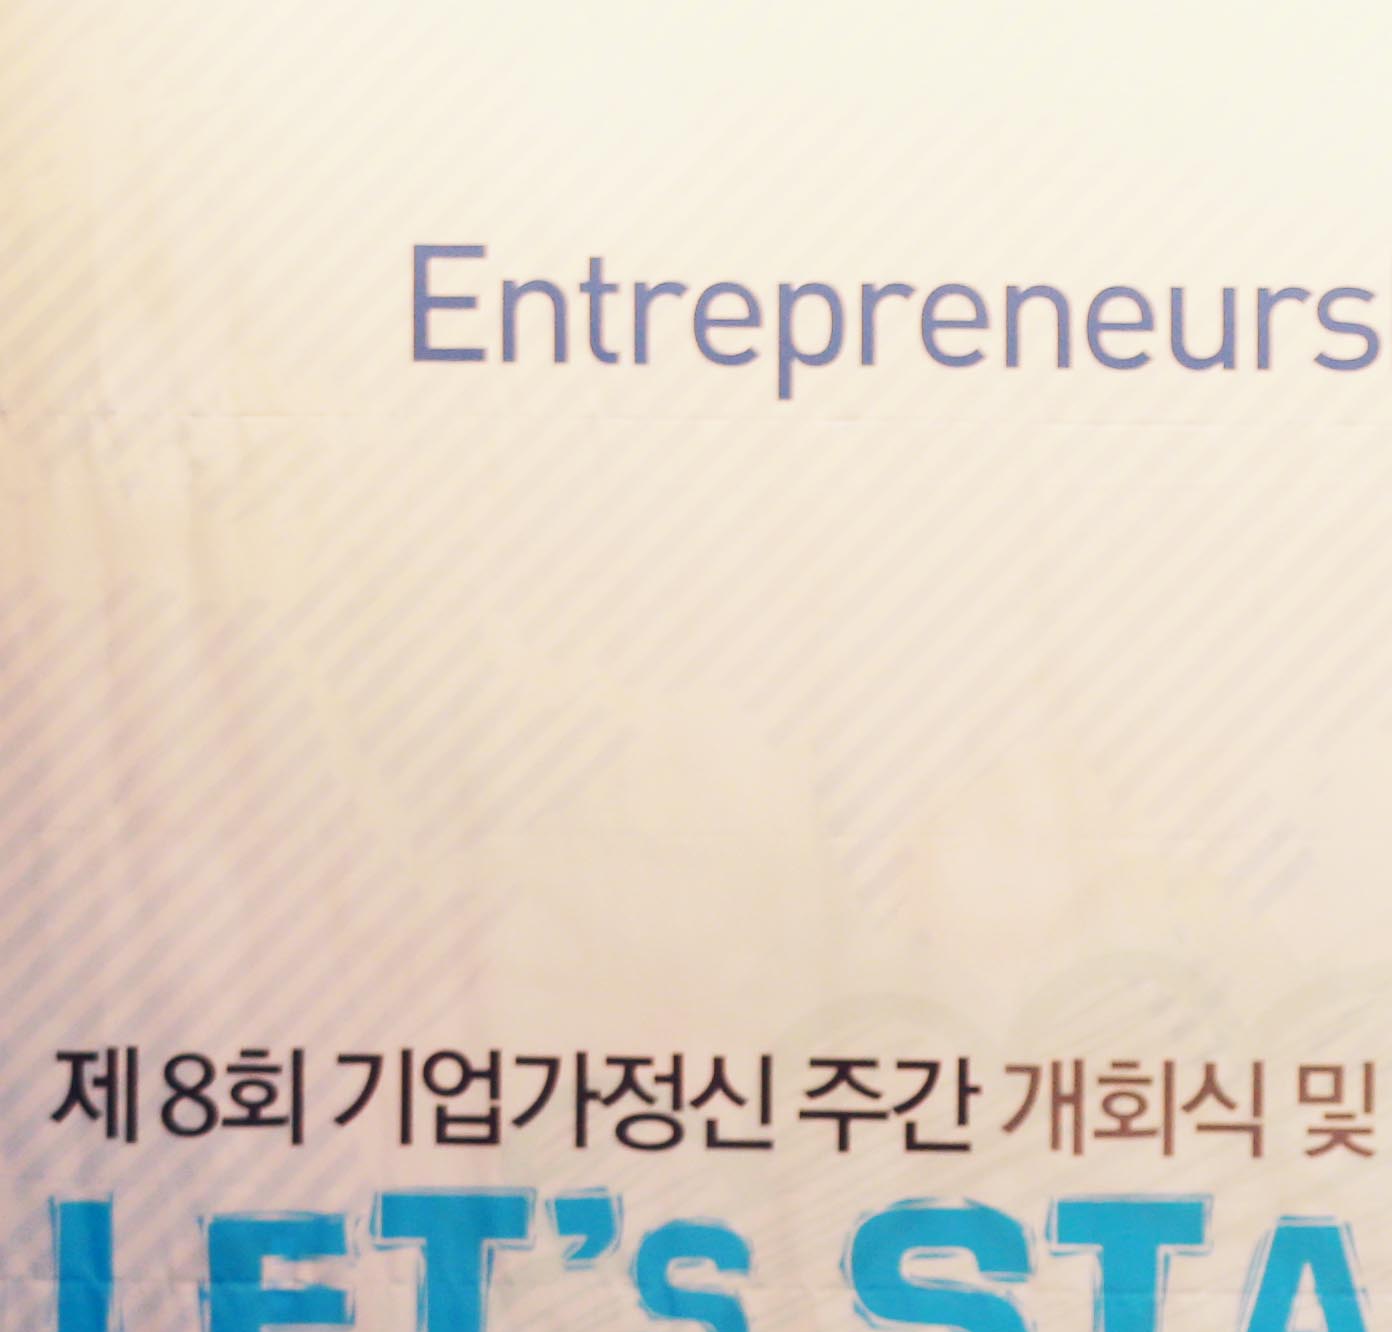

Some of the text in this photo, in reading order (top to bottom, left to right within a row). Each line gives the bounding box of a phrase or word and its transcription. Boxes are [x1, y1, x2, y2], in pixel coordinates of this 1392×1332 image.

[332, 1046, 776, 1153] 기업가정신
[797, 1055, 984, 1154] 주간
[1000, 1057, 1264, 1160] 개회식
[1297, 1060, 1375, 1159] 및
